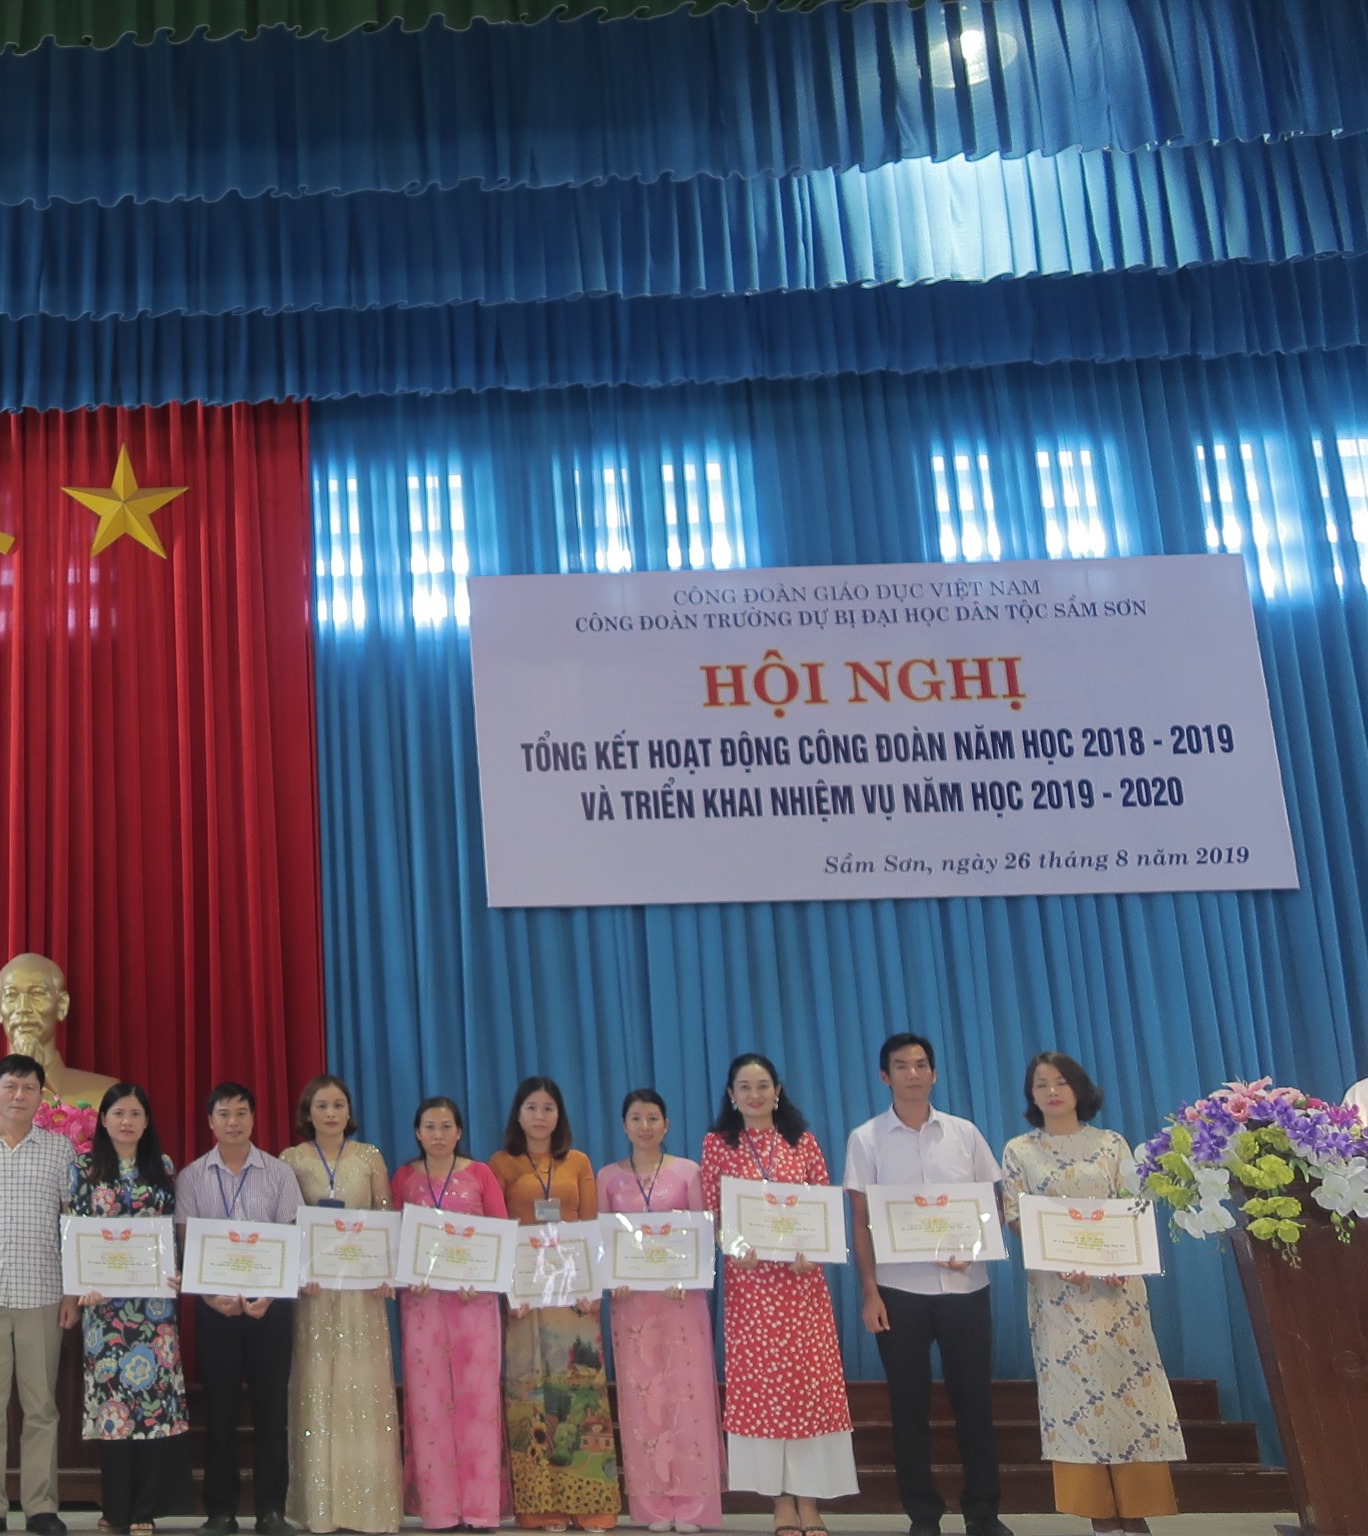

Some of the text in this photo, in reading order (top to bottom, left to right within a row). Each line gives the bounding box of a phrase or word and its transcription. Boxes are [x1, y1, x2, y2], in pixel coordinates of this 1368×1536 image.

[674, 579, 1040, 606] CÔNG ĐOÀN GIÁO DỤC VIỆT NAM
[576, 612, 633, 632] CÔNG
[639, 608, 697, 630] ĐOÀN
[704, 606, 792, 628] TRƯỜNG
[799, 608, 829, 629] DỰ
[835, 610, 856, 628] BỊ
[862, 608, 898, 628] ĐẠI
[905, 607, 949, 626] HỌC
[956, 600, 999, 621] DÂN
[1005, 600, 1047, 623] TỘC
[1104, 599, 1146, 616] SƠN
[700, 649, 1026, 719] HỘI NGHỊ
[520, 730, 587, 772] TỔNG
[595, 729, 640, 770] KẾT
[648, 738, 712, 774] HOẠT
[720, 730, 790, 773] ĐỘNG
[798, 728, 869, 765] CÔNG
[876, 726, 947, 763] ĐOÀN
[954, 724, 1015, 761] NĂM
[1022, 728, 1074, 765] HỌC
[1082, 726, 1145, 757] 2018
[1170, 724, 1234, 755] 2019
[581, 785, 615, 821] VÀ
[621, 777, 695, 820] TRIỂN
[703, 787, 763, 818] KHAI
[770, 779, 855, 823] NHIỆM
[861, 784, 895, 821] VỤ
[903, 777, 964, 813] NĂM
[971, 780, 1023, 818] HỌC
[1031, 779, 1094, 810] 2019
[1120, 776, 1184, 807] 2020
[884, 855, 932, 875] Sơn,
[942, 853, 997, 875] ngày
[1005, 852, 1030, 869] 26
[1039, 851, 1108, 871] tháng
[1116, 849, 1128, 867] 8
[1137, 849, 1189, 866] năm
[1196, 846, 1249, 864] 2019
